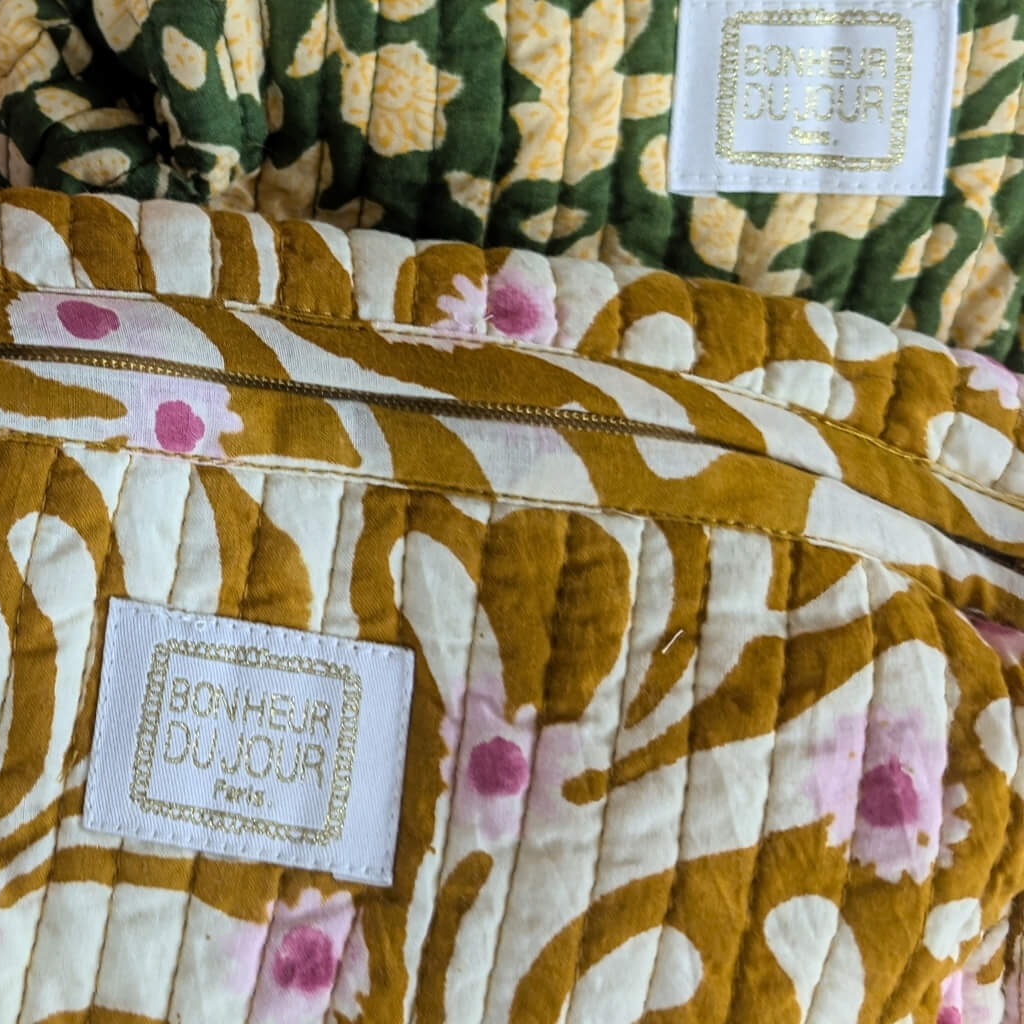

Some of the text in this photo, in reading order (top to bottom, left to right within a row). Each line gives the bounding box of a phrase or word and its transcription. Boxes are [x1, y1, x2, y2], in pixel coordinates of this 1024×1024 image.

[743, 44, 887, 79] BONHEUR
[743, 82, 885, 123] DU JOUR
[168, 677, 332, 737] BONHEUR
[163, 720, 325, 788] DU JOUR
